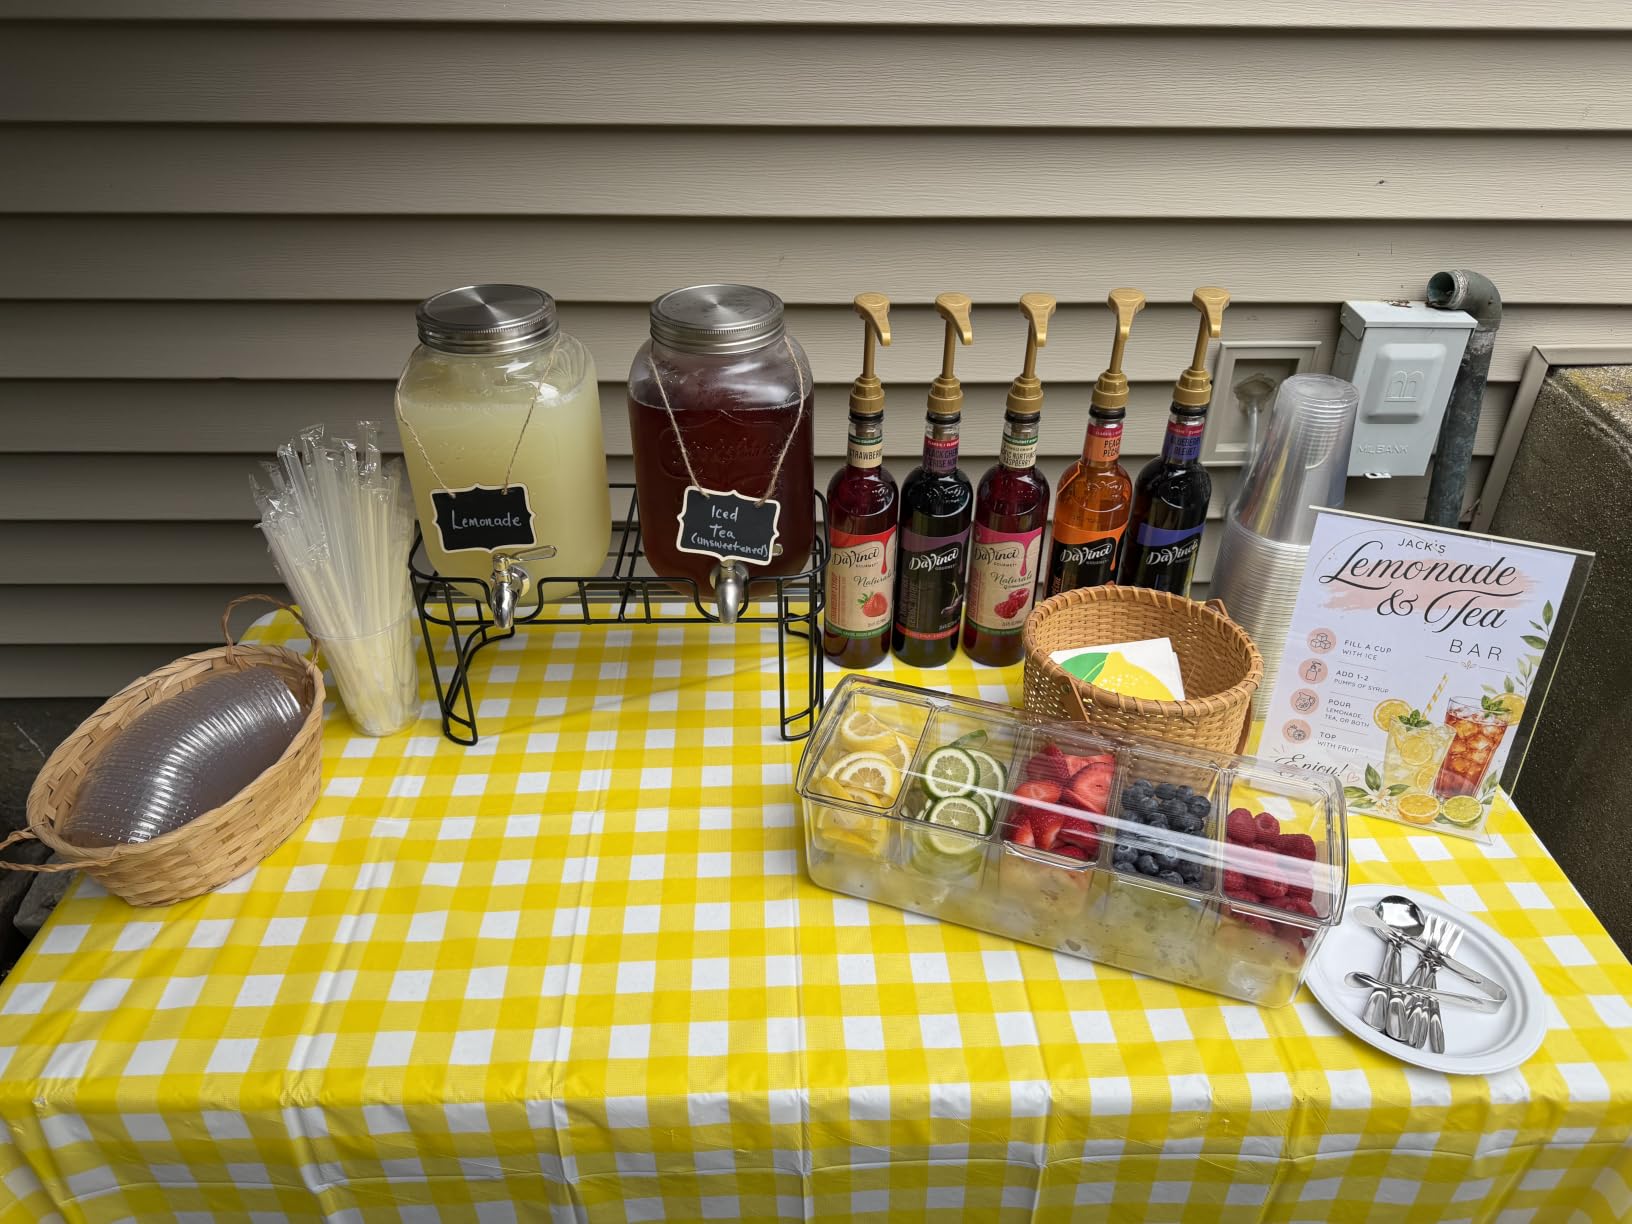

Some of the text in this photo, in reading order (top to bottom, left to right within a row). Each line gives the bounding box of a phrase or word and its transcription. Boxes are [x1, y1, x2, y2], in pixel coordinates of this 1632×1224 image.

[452, 509, 522, 530] Lemonade
[711, 505, 739, 522] Iced
[709, 523, 736, 539] Tea
[691, 532, 768, 557] (unsweetened)
[1398, 537, 1446, 554] JACK'S
[832, 546, 879, 568] DaVinci
[909, 547, 959, 572] DaVinci
[975, 546, 1019, 564] DaVinci
[1060, 543, 1112, 565] DaVinci
[1319, 540, 1517, 590] Lemonade
[991, 571, 1032, 585] Naturals
[1377, 588, 1524, 633] & Tea
[1342, 649, 1377, 661] WITH ICE
[1344, 640, 1361, 649] FILL
[1374, 645, 1392, 653] CUP
[1449, 638, 1502, 661] BAR
[1336, 670, 1354, 678] ADD
[1334, 679, 1356, 688] PUMPS
[1367, 685, 1389, 694] SYRUP
[1328, 699, 1351, 708] POUR
[1325, 714, 1338, 722] TEA,
[1317, 741, 1359, 753] WITH FRUIT
